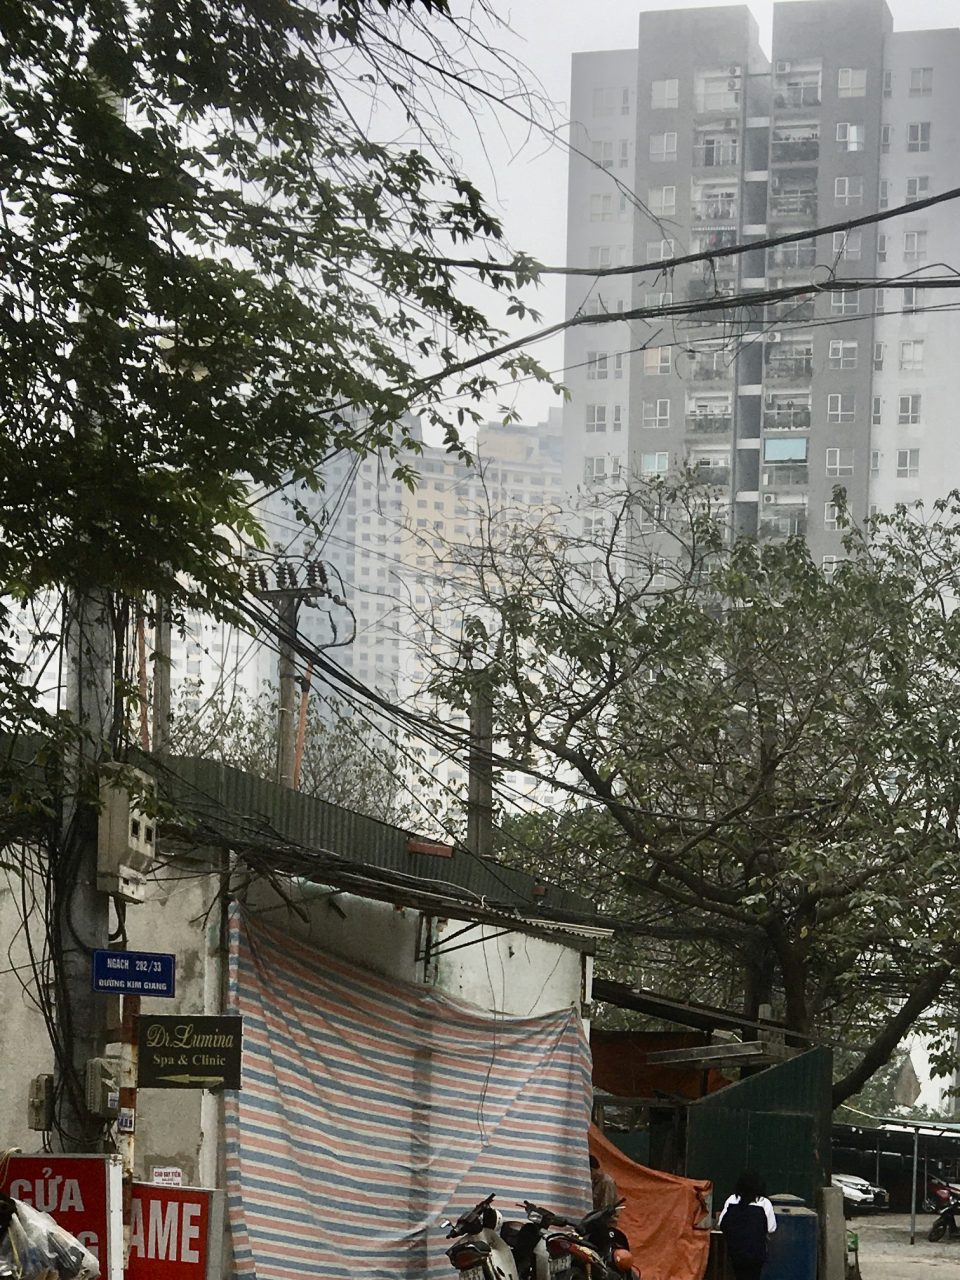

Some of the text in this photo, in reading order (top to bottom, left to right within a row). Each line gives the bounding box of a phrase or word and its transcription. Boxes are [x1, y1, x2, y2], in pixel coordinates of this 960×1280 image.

[127, 980, 142, 989] KIM
[144, 982, 167, 990] GIANG
[153, 1054, 226, 1067] Spa & Clinic
[9, 1167, 85, 1212] CỬA
[128, 1197, 201, 1264] AME
